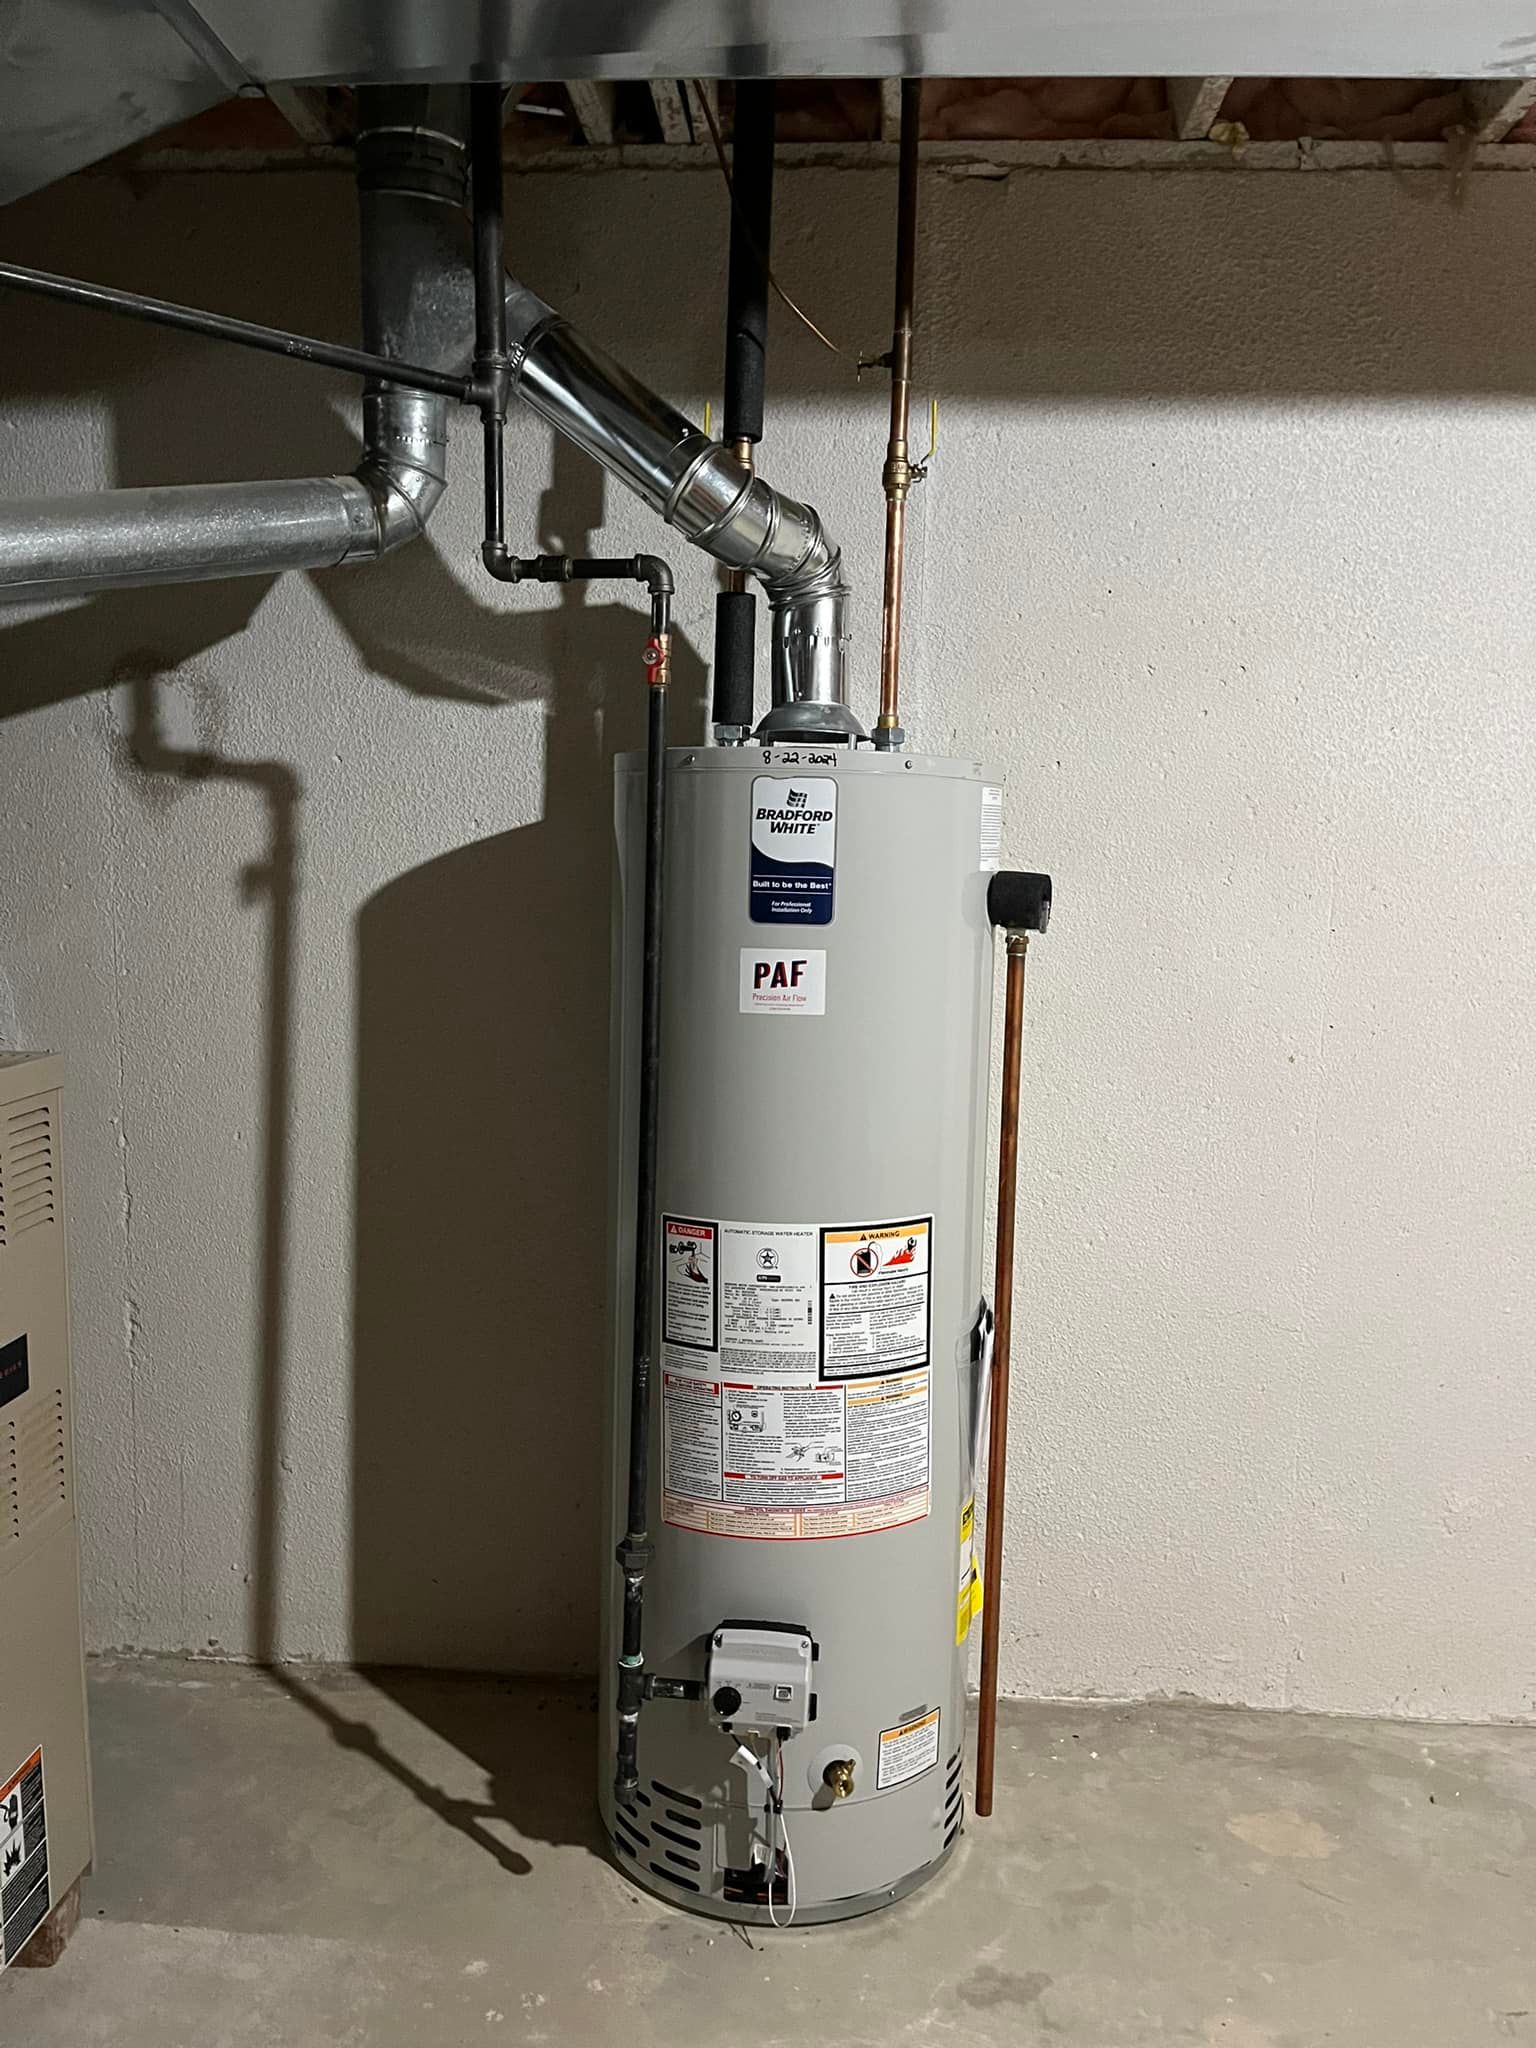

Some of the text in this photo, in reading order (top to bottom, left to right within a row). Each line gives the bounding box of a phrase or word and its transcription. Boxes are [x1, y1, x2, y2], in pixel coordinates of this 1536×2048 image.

[763, 750, 837, 767] 8-22-2024
[756, 808, 833, 822] BRADFORD
[770, 821, 817, 834] WHITE
[752, 880, 770, 888] Built
[782, 881, 793, 889] be
[753, 960, 808, 989] PAF
[752, 992, 781, 1001] Precision
[792, 994, 807, 1002] Flow
[677, 1226, 706, 1237] DANGER
[868, 1230, 901, 1239] WARNING
